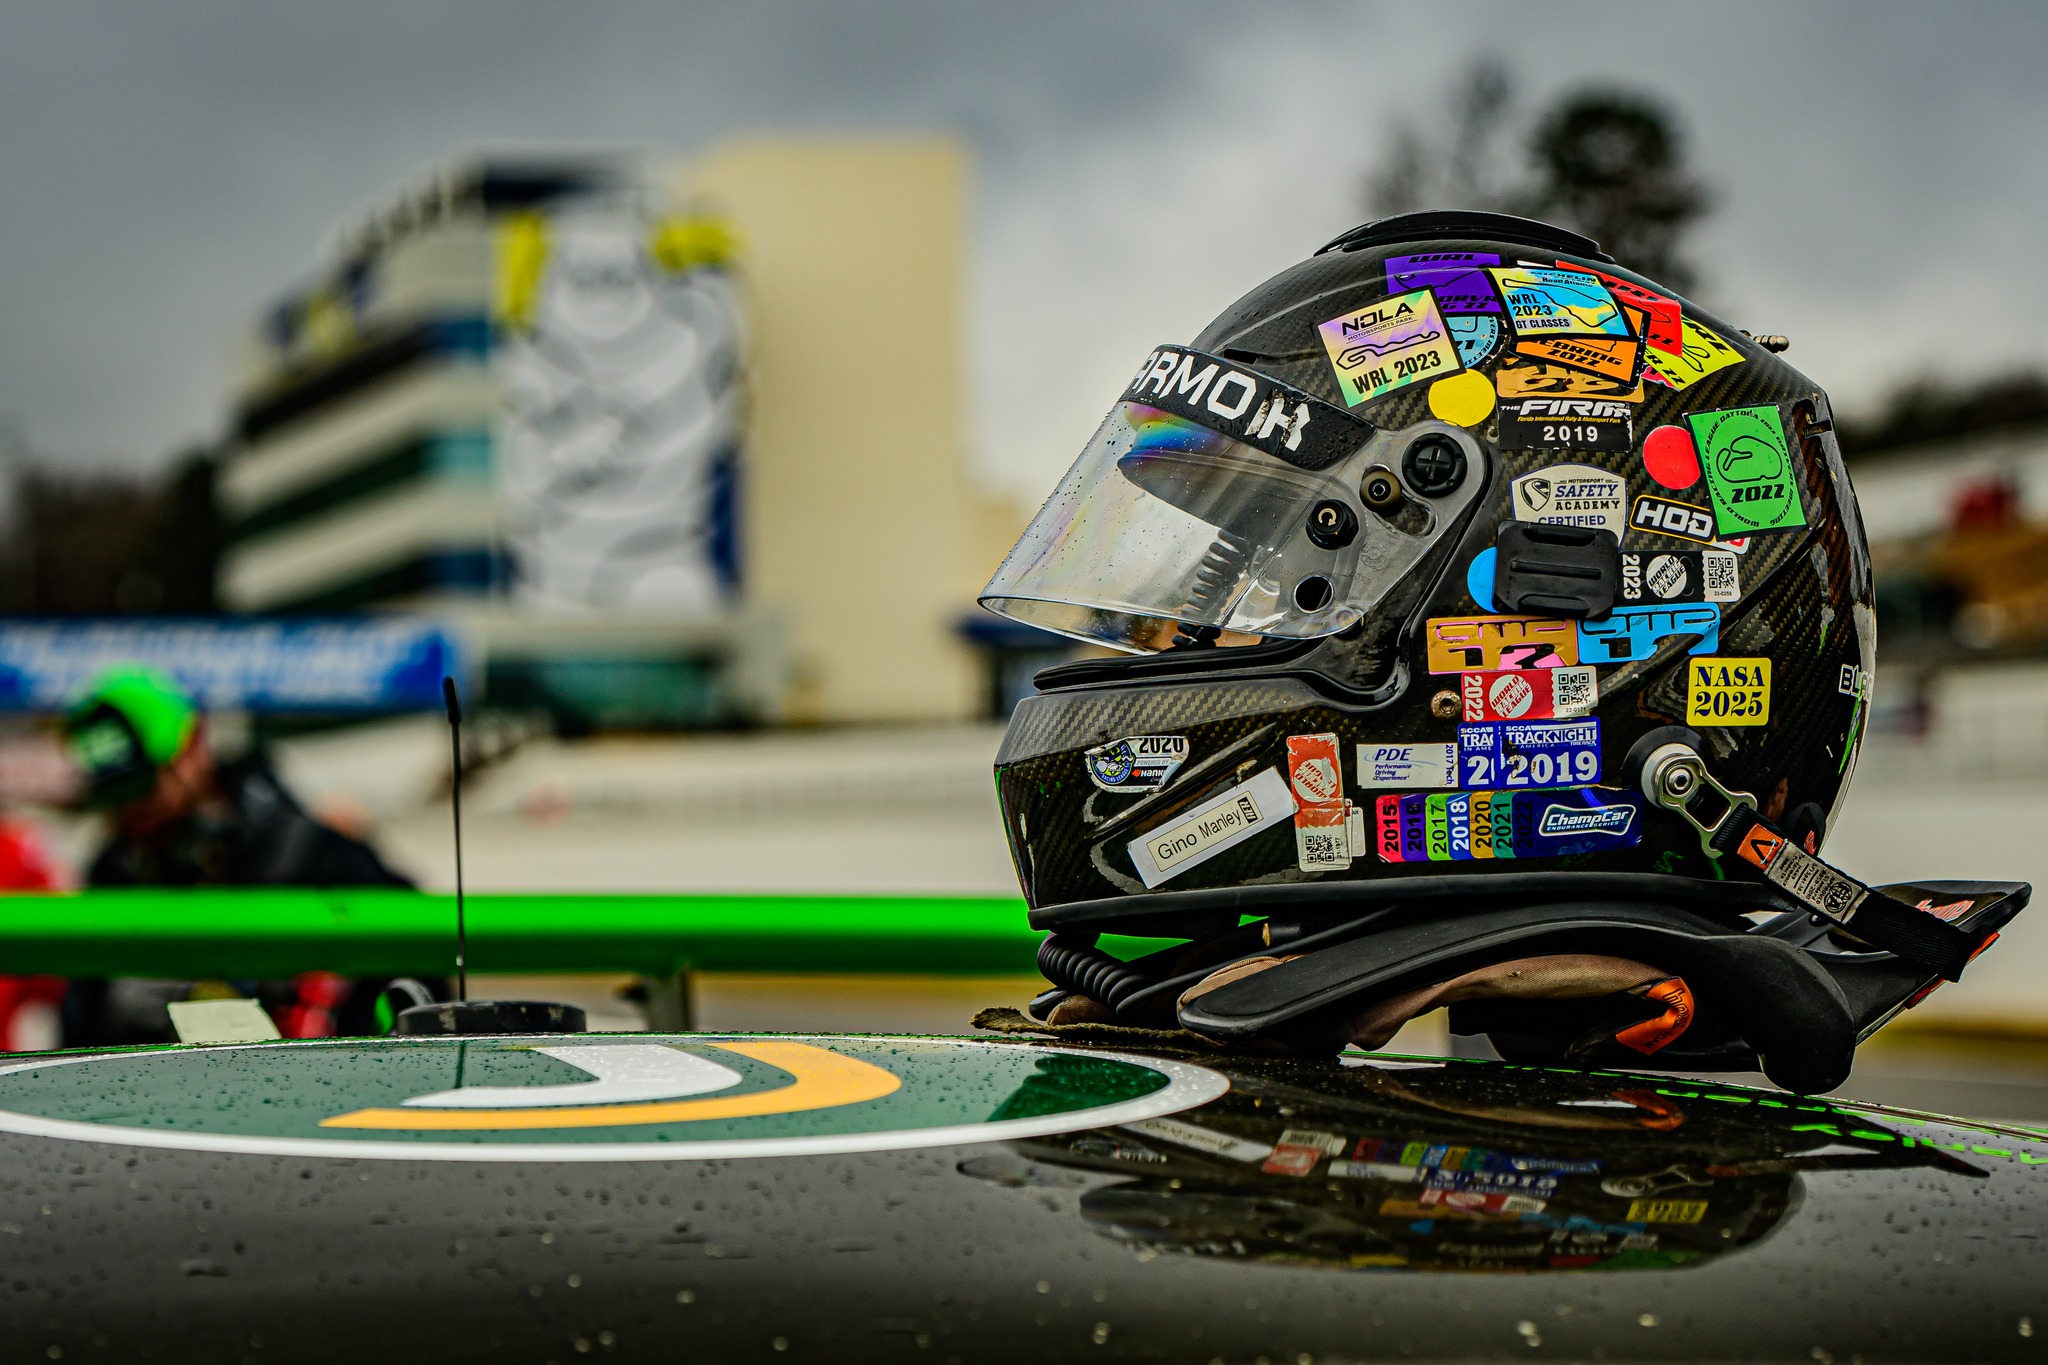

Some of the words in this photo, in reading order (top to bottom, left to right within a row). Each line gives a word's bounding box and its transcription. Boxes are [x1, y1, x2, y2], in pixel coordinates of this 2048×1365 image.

[1507, 293, 1540, 305] WRL
[1513, 304, 1553, 316] 2023
[1342, 302, 1414, 337] NOLA
[1347, 320, 1395, 341] MOTORSPORTS
[1395, 316, 1414, 325] PARK
[1515, 320, 1529, 329] GT
[1530, 318, 1571, 328] CLASSES
[1538, 339, 1623, 366] EBRING
[1352, 366, 1392, 395] WRL
[1393, 350, 1442, 379] 2023
[1519, 400, 1631, 417] FIRM
[1582, 416, 1609, 424] Motorsport
[1543, 425, 1598, 442] 2019
[1704, 420, 1719, 461] LEAGUE
[1554, 484, 1619, 498] SAFETY
[1731, 483, 1785, 504] 2022
[1555, 500, 1621, 511] ACADEMY
[1538, 515, 1606, 527] CERTIFIED
[1622, 554, 1642, 600] 2023
[1648, 555, 1676, 587] WORLD
[1658, 563, 1687, 598] LEAGUE
[1695, 666, 1765, 687] NASA
[1464, 675, 1485, 721] 2022
[1491, 675, 1519, 708] WORLD
[1501, 682, 1532, 718] LEAGUE
[1694, 691, 1764, 717] 2025
[1139, 738, 1185, 753] 2020
[1374, 748, 1413, 761] PDE
[1445, 744, 1453, 764] 2017
[1506, 750, 1598, 786] 2019
[1383, 804, 1399, 852] 2015
[1406, 802, 1422, 852] 2016
[1431, 803, 1447, 854] 2017
[1450, 801, 1469, 851] 2018
[1474, 800, 1492, 848] 2020
[1494, 802, 1513, 850] 2021
[1516, 801, 1534, 849] 2022
[1546, 810, 1629, 827] ChampCar
[1546, 823, 1590, 831] ENDURANCE
[1157, 833, 1198, 860] Gino
[1198, 808, 1241, 839] Manley
